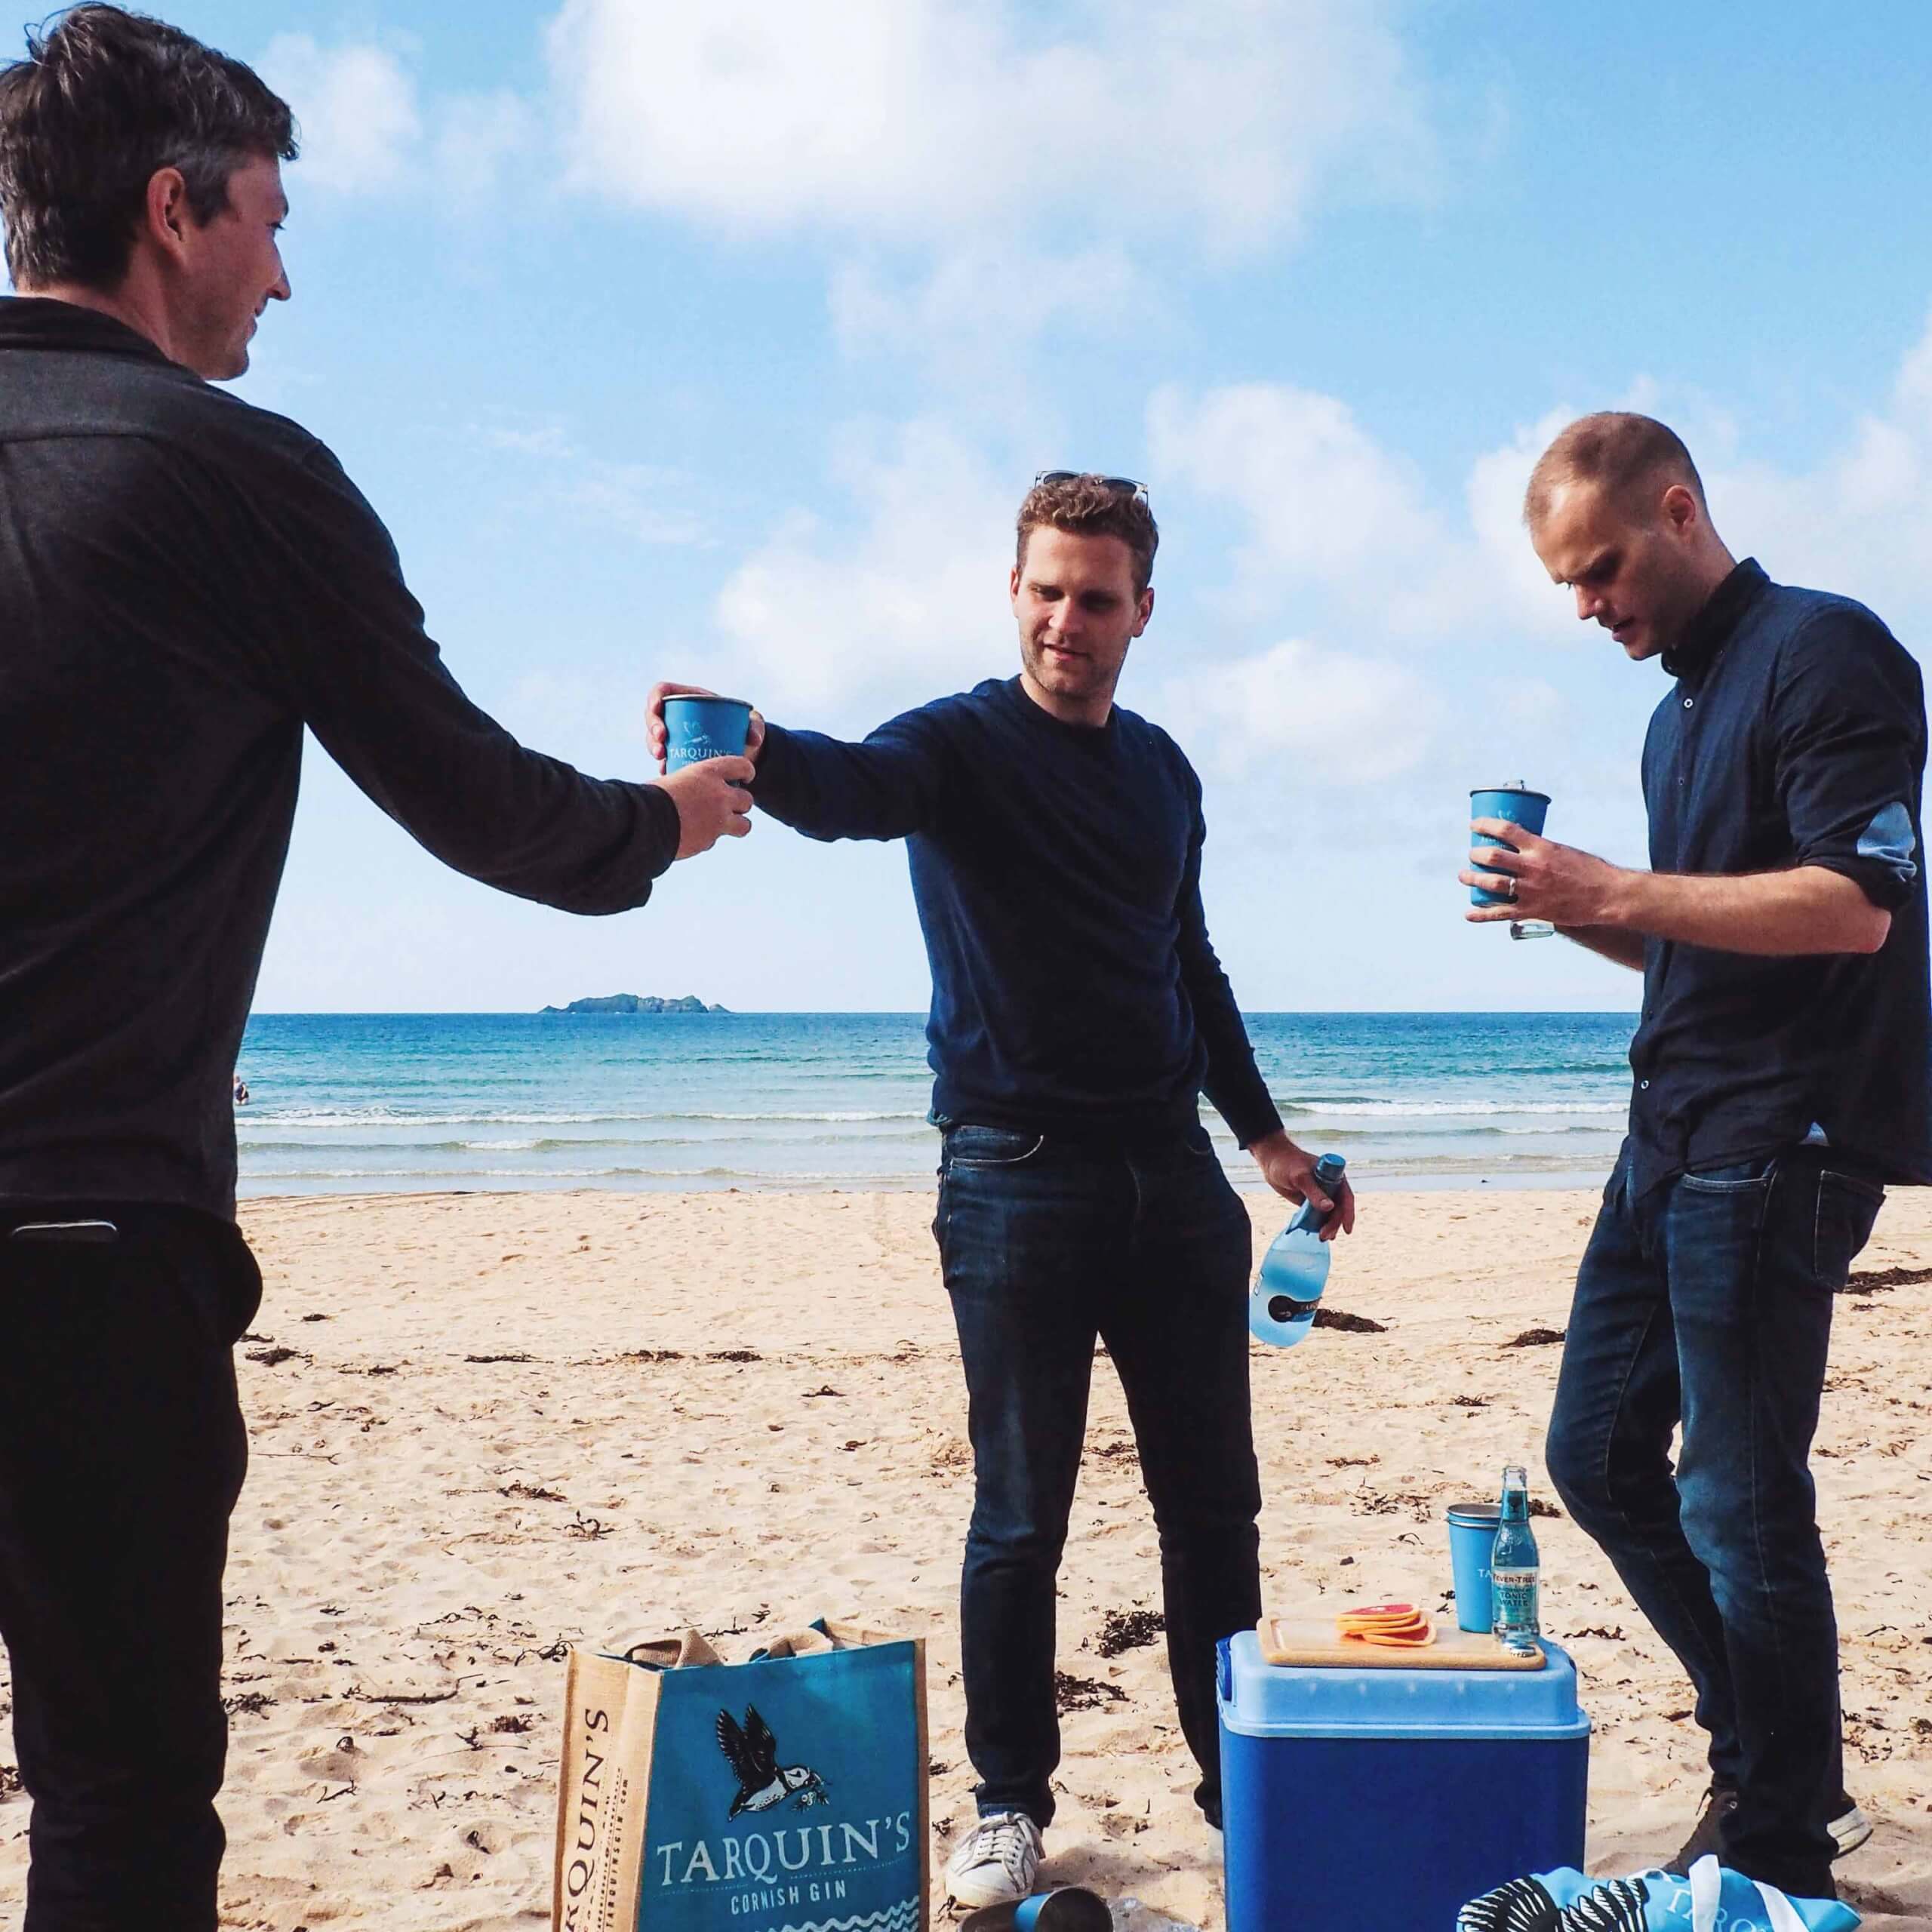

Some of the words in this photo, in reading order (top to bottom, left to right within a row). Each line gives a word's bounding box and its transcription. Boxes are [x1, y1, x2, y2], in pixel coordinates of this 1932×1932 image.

[657, 1811, 910, 1886] TARQUIN'S
[731, 1886, 799, 1915] CORNISH
[809, 1878, 846, 1902] GIN
